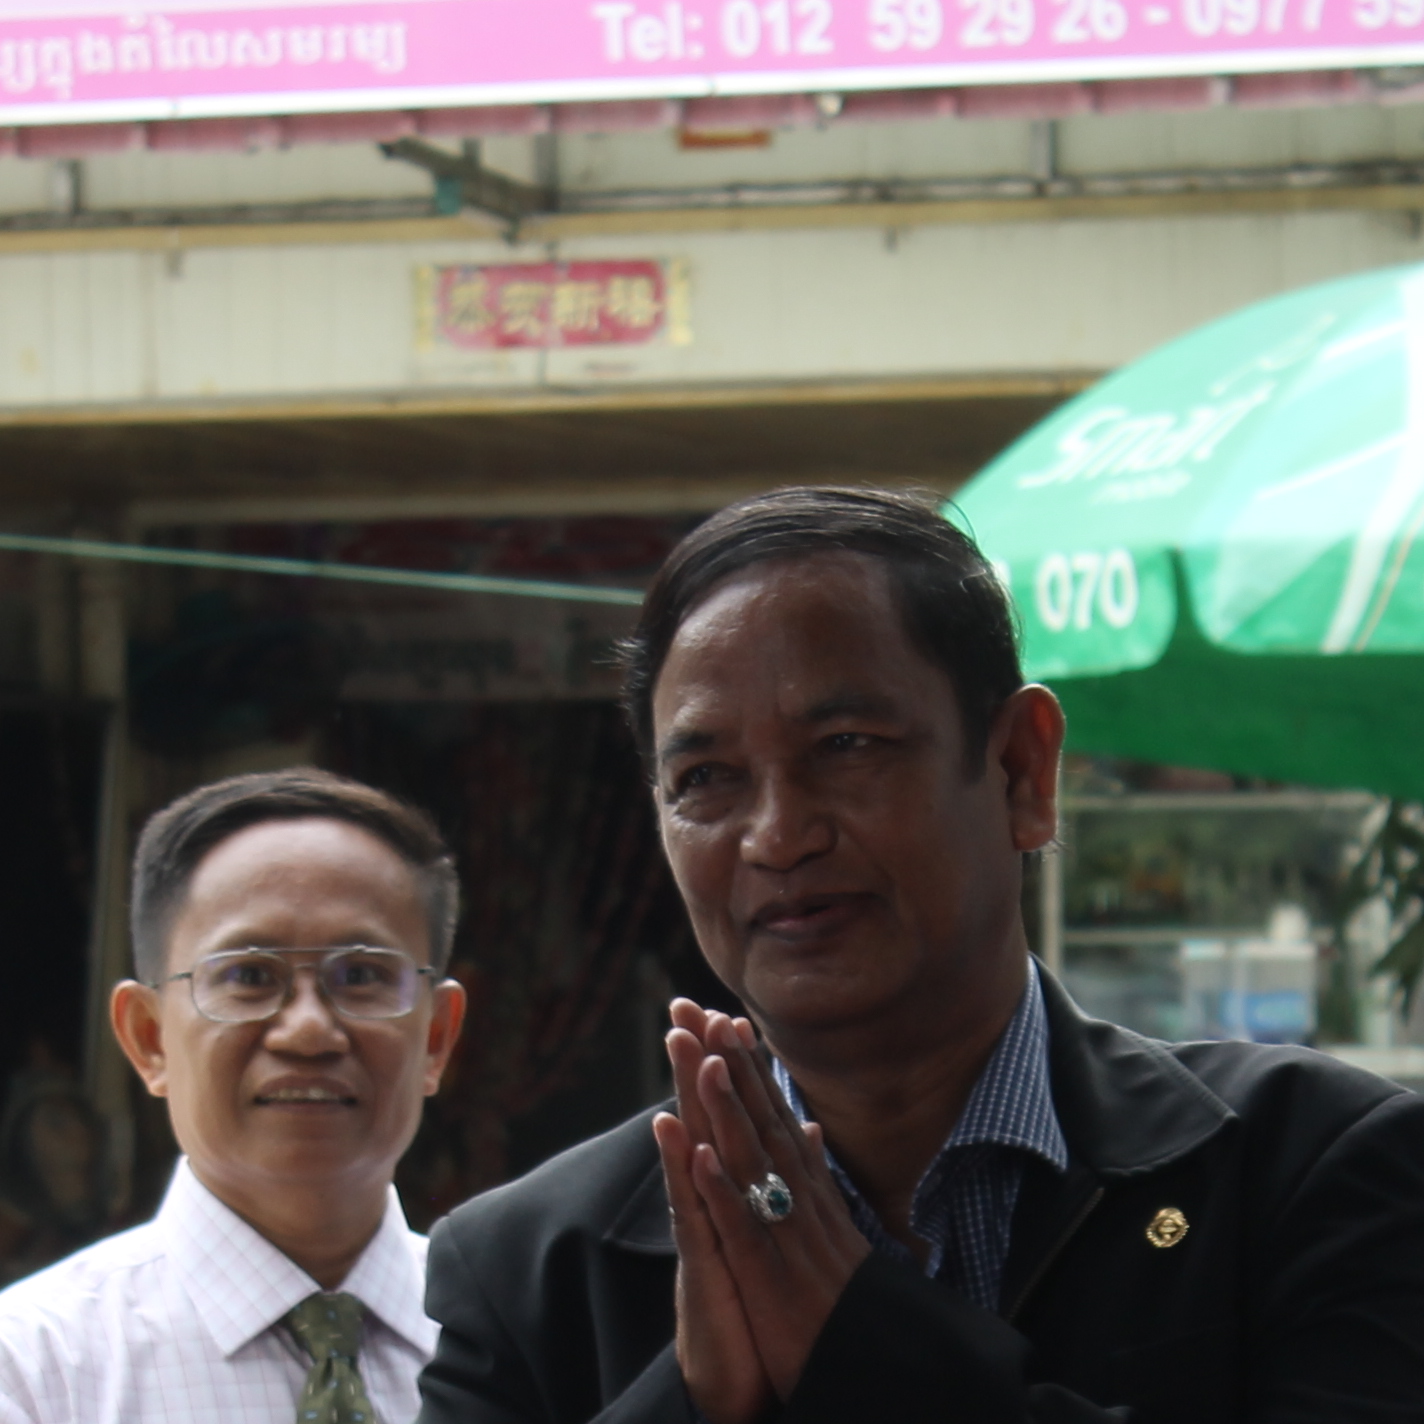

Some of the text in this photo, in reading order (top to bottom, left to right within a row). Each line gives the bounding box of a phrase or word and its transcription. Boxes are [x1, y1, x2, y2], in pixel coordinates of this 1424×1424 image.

[592, 3, 704, 61] Tel:
[719, 1, 836, 58] 012
[869, 0, 944, 51] 59
[958, 0, 1036, 48] 29
[1052, 0, 1130, 43] 26
[1035, 547, 1139, 633] 070
